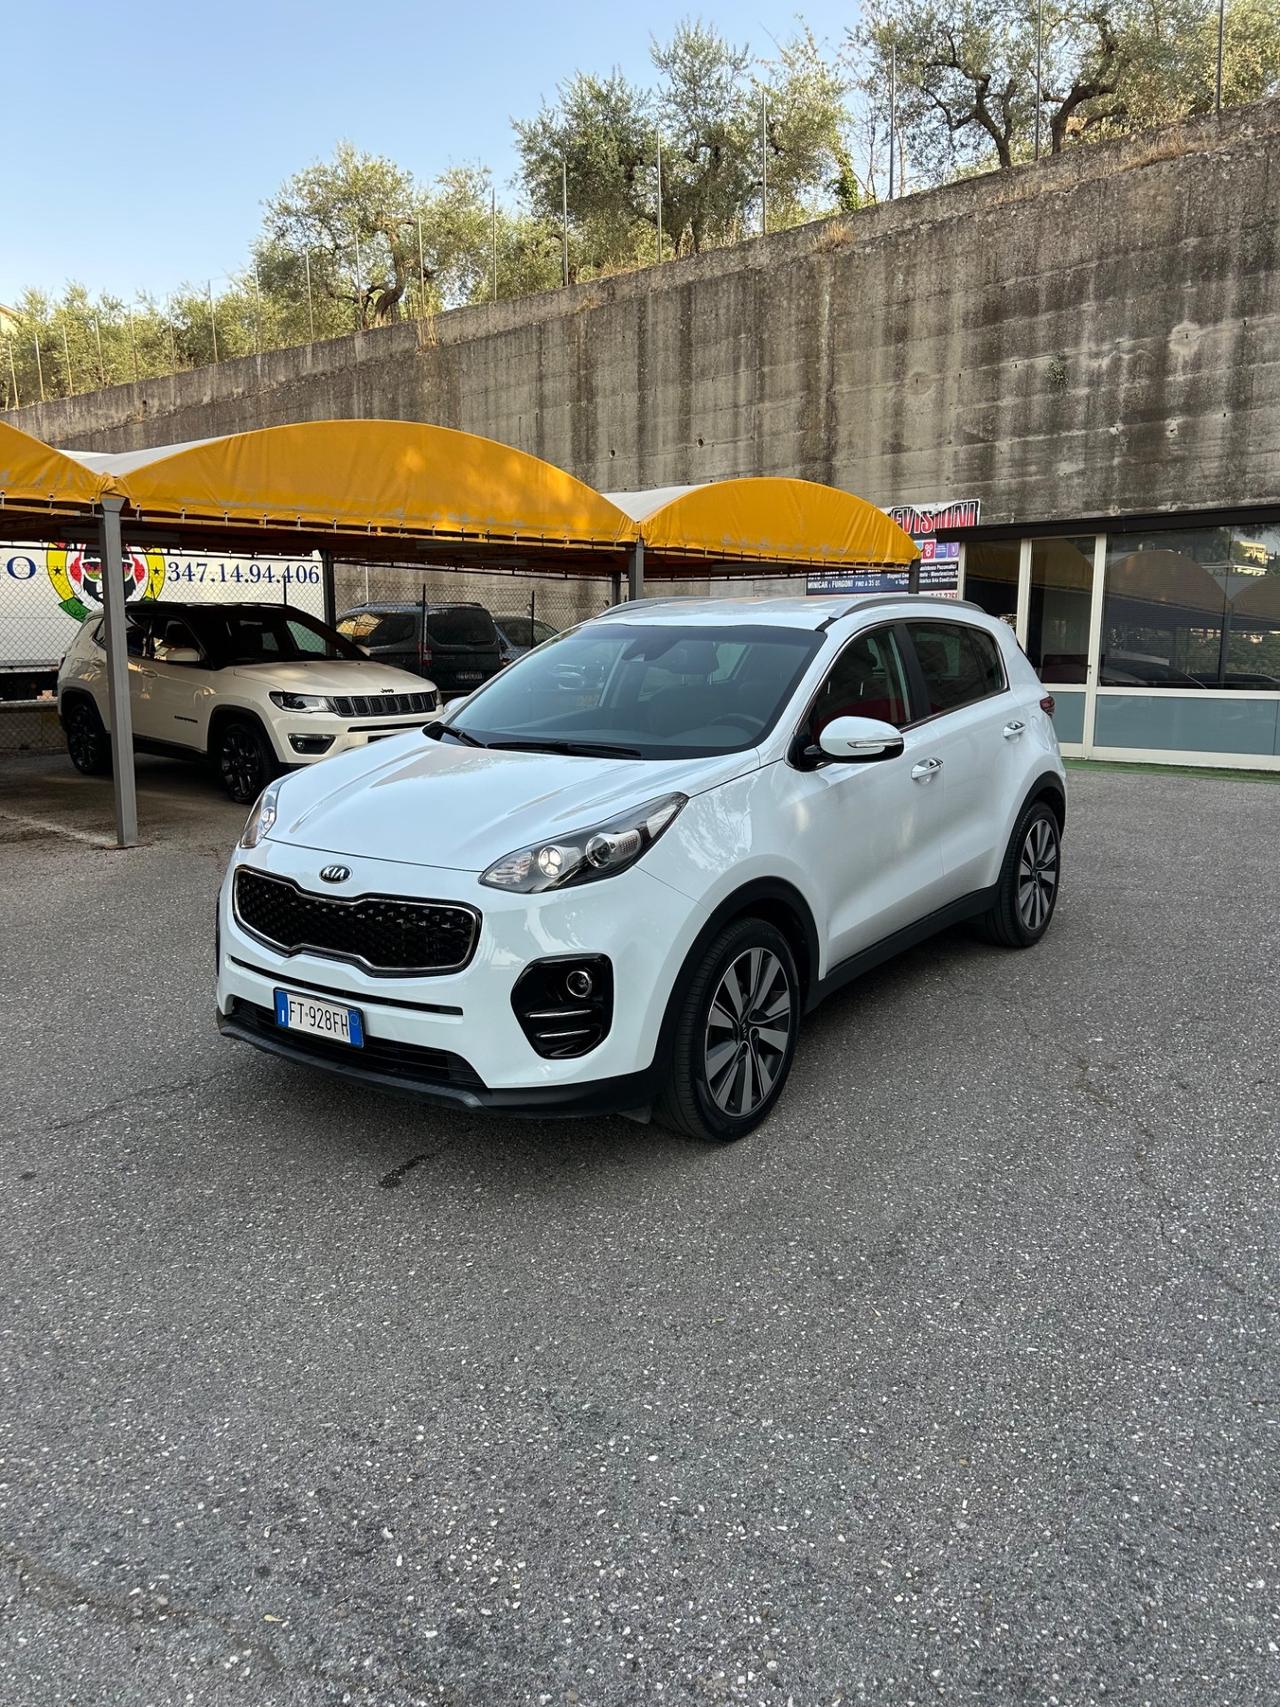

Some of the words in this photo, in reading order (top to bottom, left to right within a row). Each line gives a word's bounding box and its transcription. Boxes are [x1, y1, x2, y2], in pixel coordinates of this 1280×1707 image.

[892, 502, 976, 534] EVISIONI
[167, 561, 320, 584] 347.14.94.406
[807, 581, 828, 589] MINICAR
[832, 580, 853, 588] FURGONI
[322, 866, 346, 879] KIA
